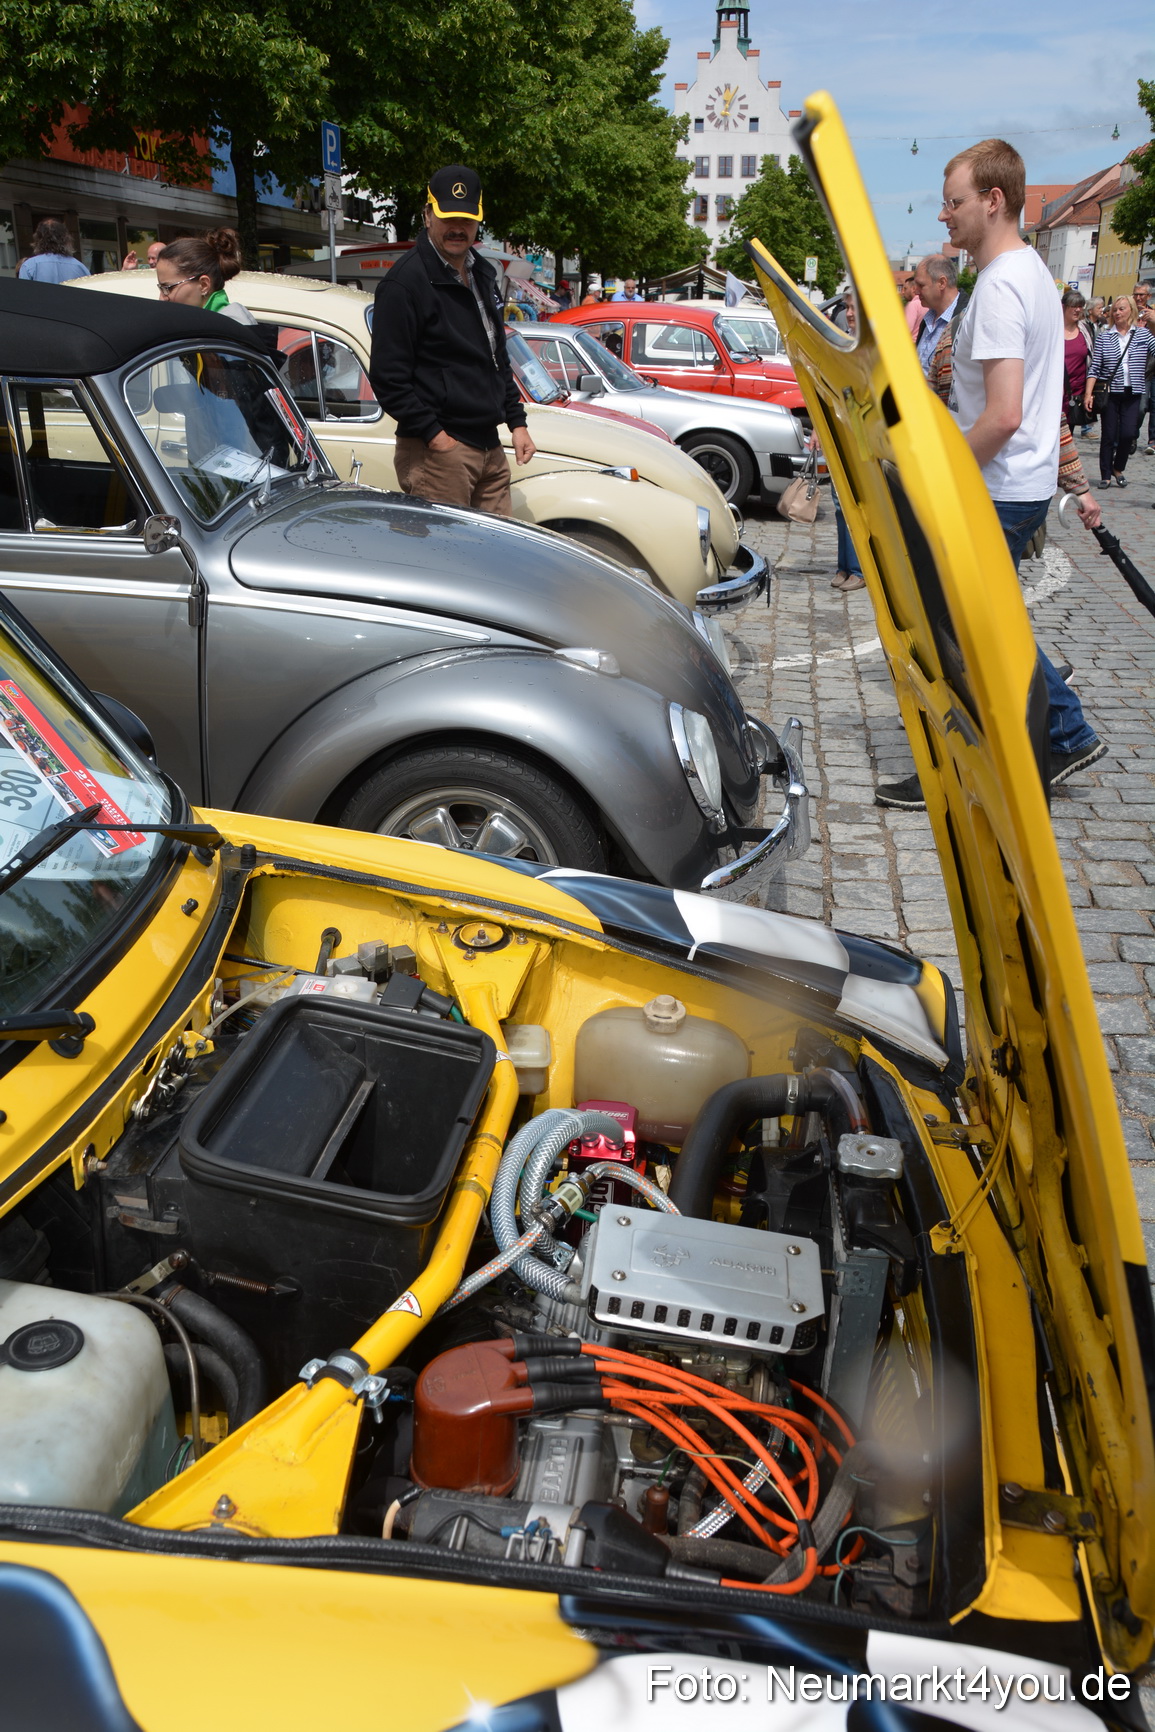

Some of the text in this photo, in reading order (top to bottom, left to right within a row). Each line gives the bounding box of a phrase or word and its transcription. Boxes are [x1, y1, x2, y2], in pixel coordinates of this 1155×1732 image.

[326, 129, 336, 165] P
[0, 769, 43, 811] 580
[540, 1437, 569, 1504] BARTH
